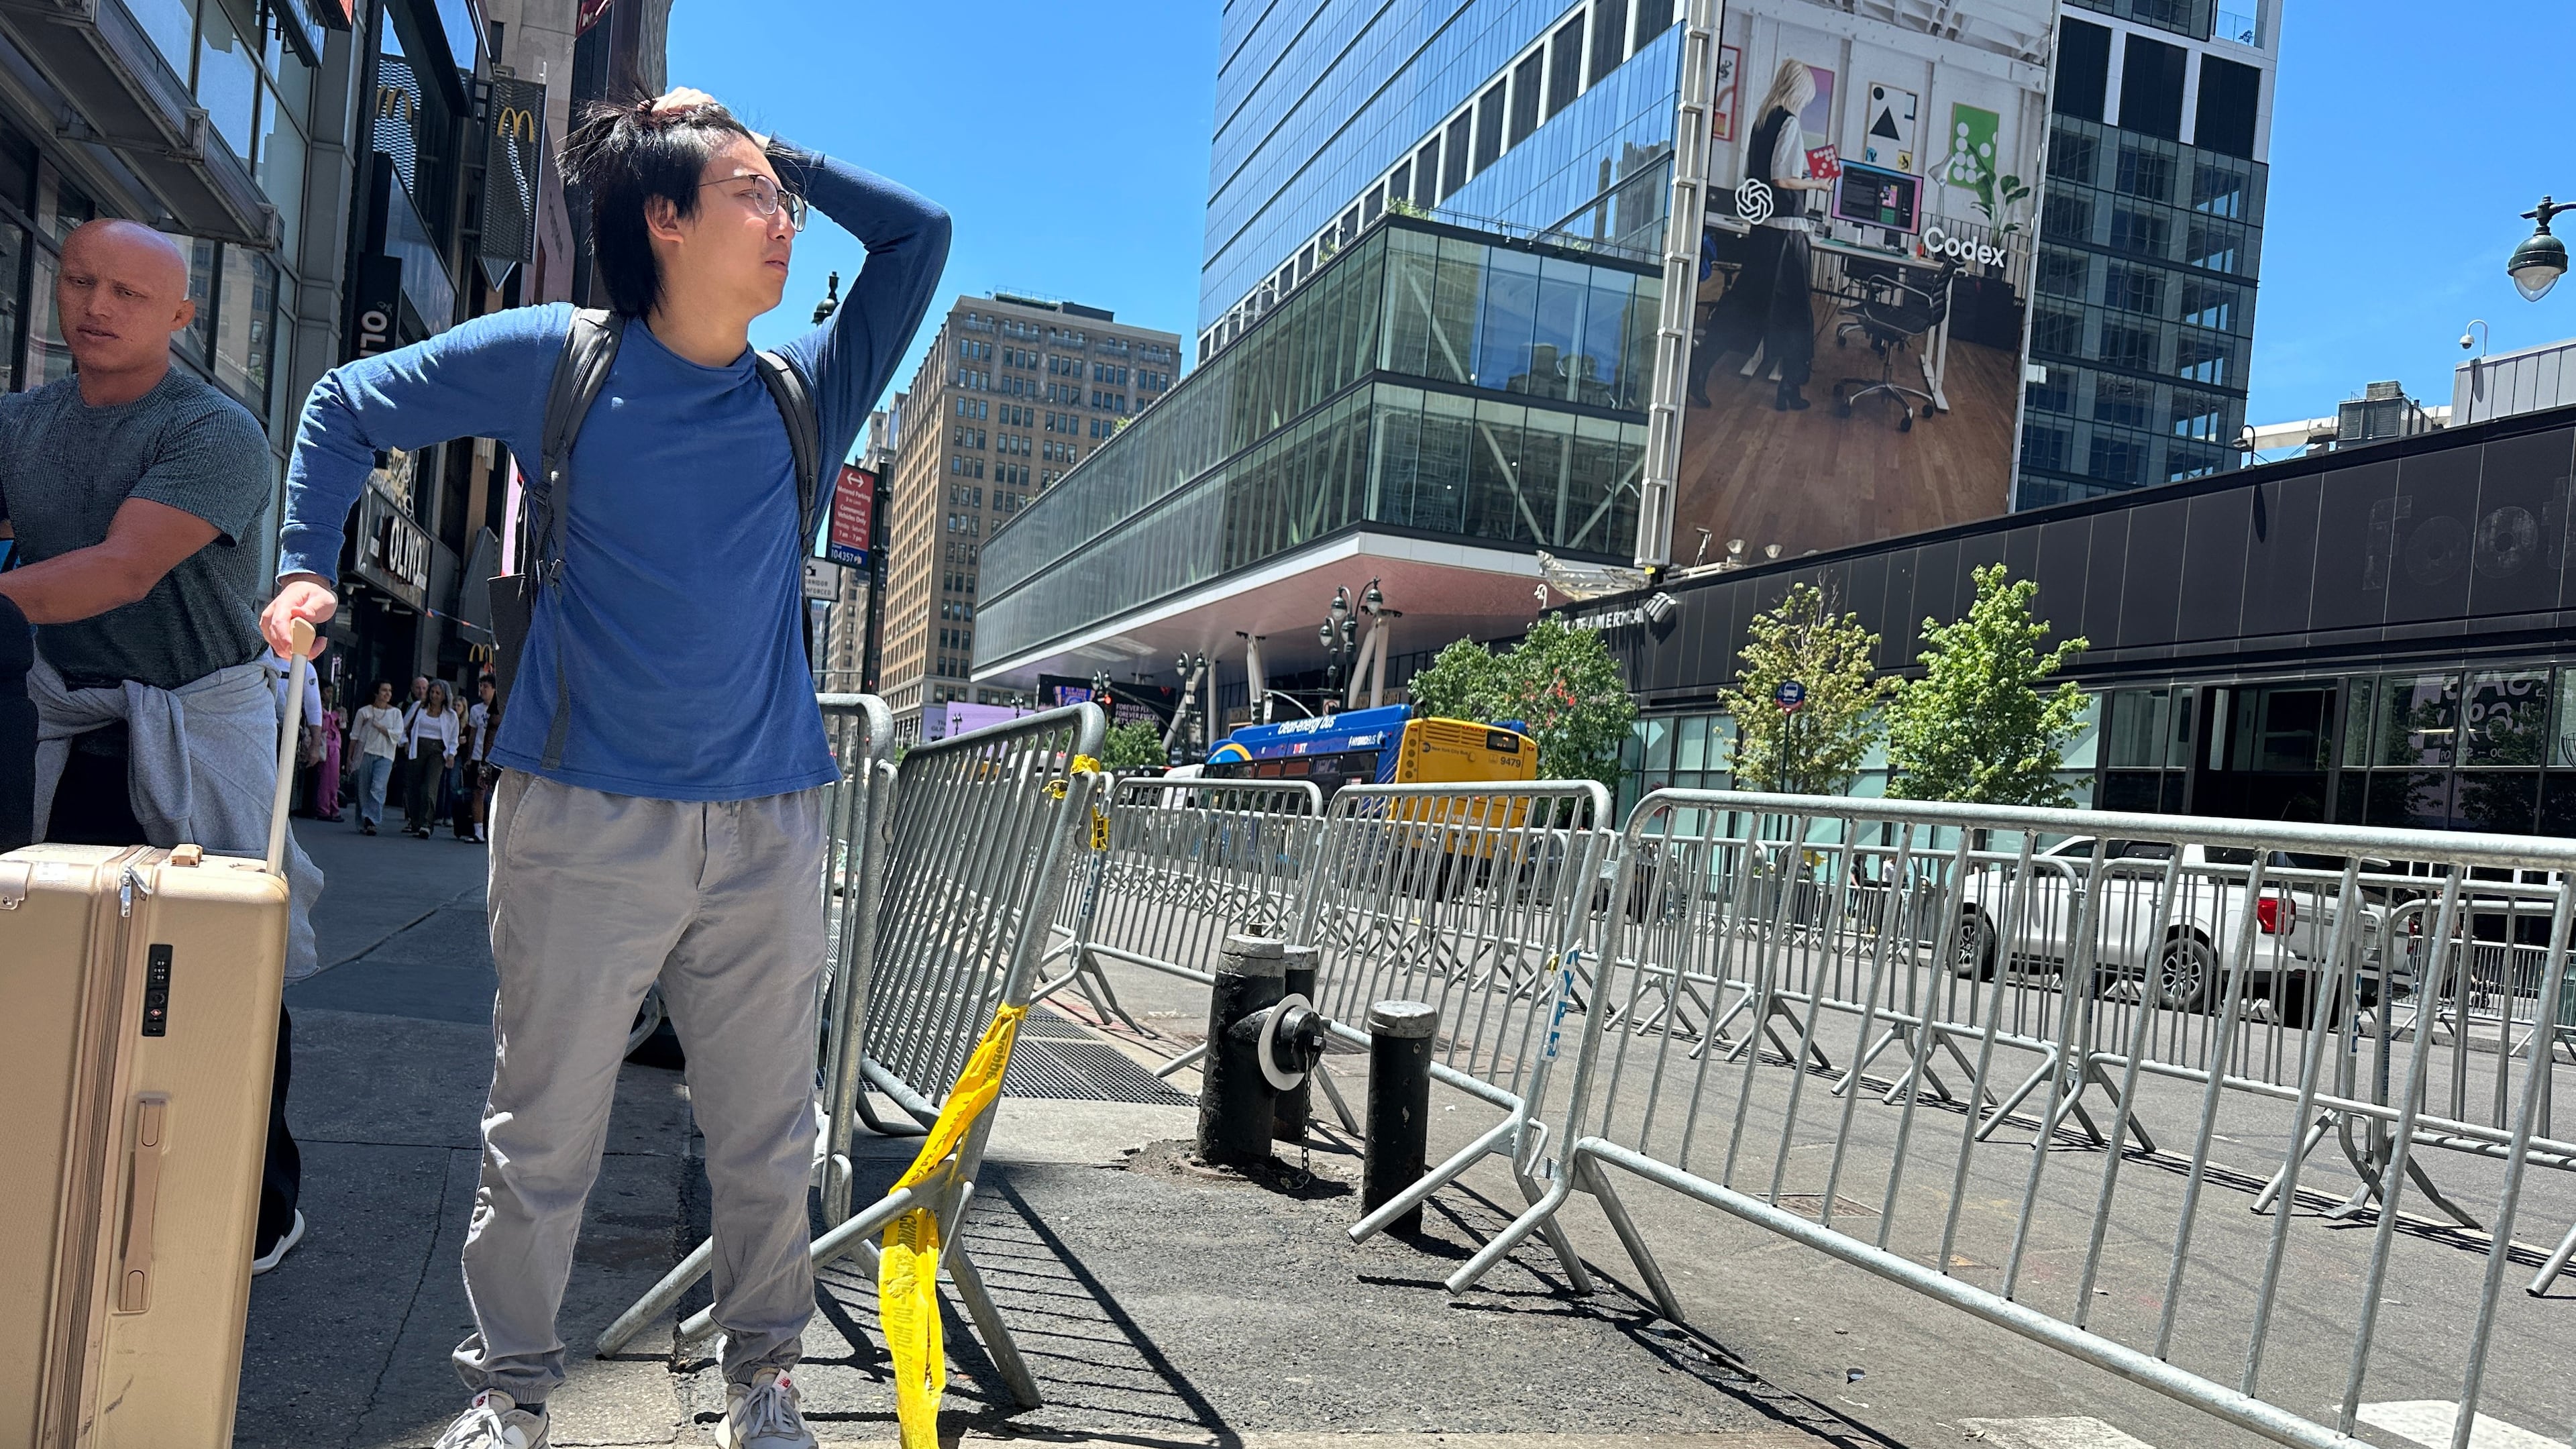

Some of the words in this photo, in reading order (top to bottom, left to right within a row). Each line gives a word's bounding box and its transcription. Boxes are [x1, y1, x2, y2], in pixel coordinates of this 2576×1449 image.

[1924, 227, 2006, 268] Codex
[855, 490, 871, 502] Parking
[856, 516, 867, 526] Only
[830, 548, 854, 563] 104357
[806, 587, 832, 596] NFORCED
[1116, 703, 1140, 712] FOREVER
[1116, 710, 1139, 718] FOREVER
[1277, 716, 1324, 736] clean-energy
[1320, 715, 1337, 730] bus
[1500, 756, 1521, 768] 9479
[2384, 972, 2393, 994] Long
